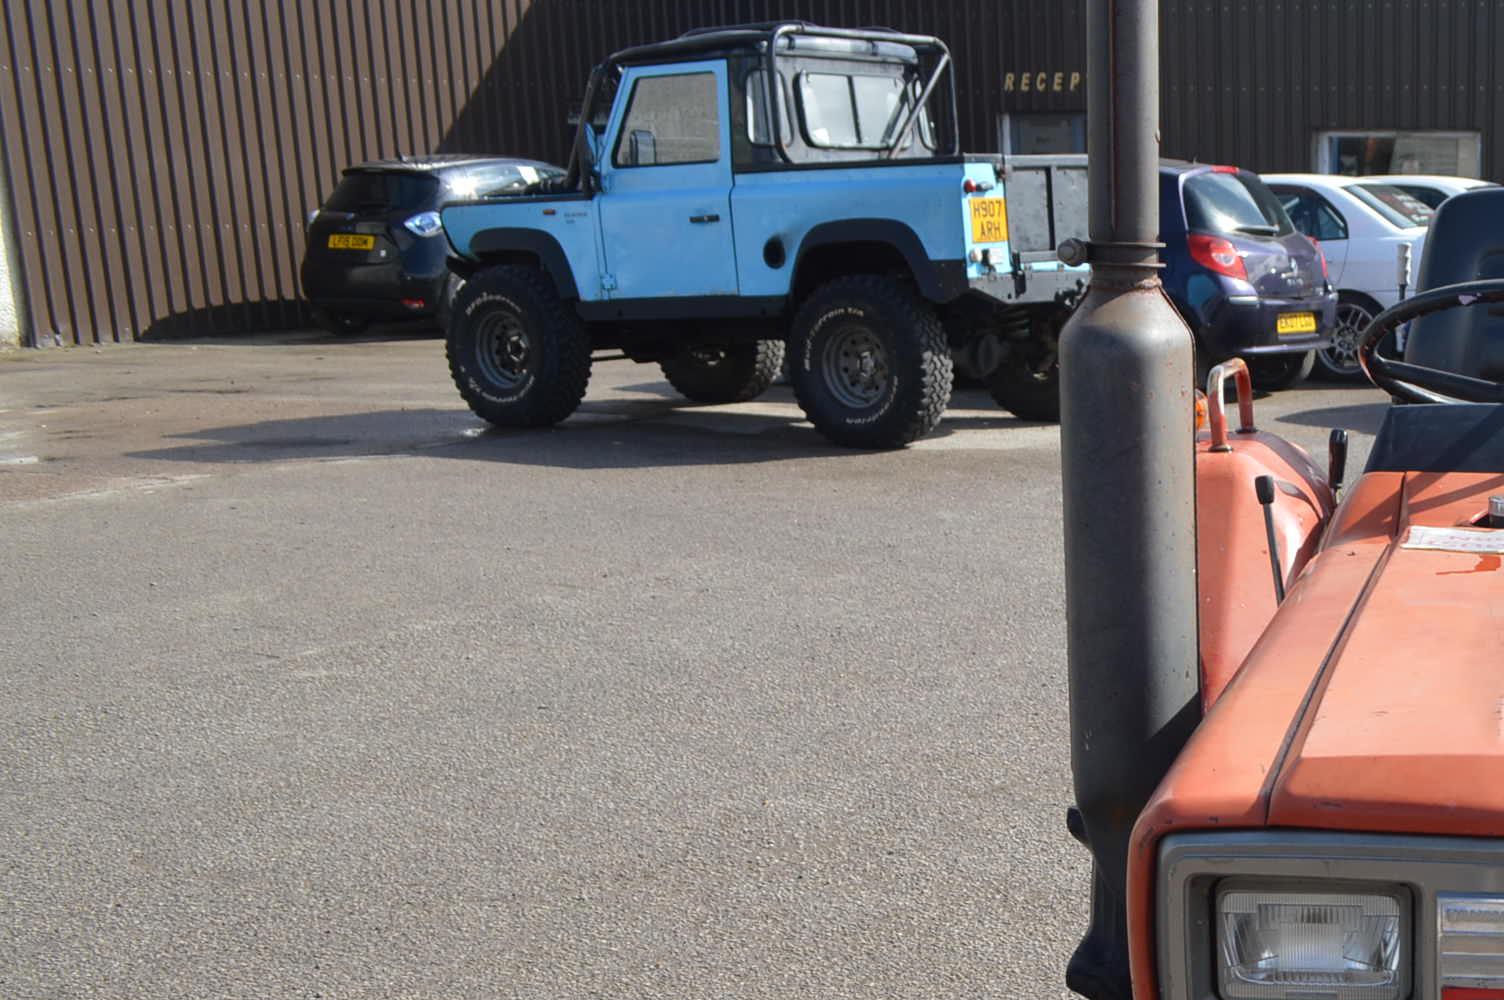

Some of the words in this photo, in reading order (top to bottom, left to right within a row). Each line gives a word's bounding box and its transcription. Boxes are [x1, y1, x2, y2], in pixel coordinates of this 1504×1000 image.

[1004, 72, 1086, 92] RECEP
[973, 200, 1002, 218] H907
[980, 221, 1002, 240] ARH
